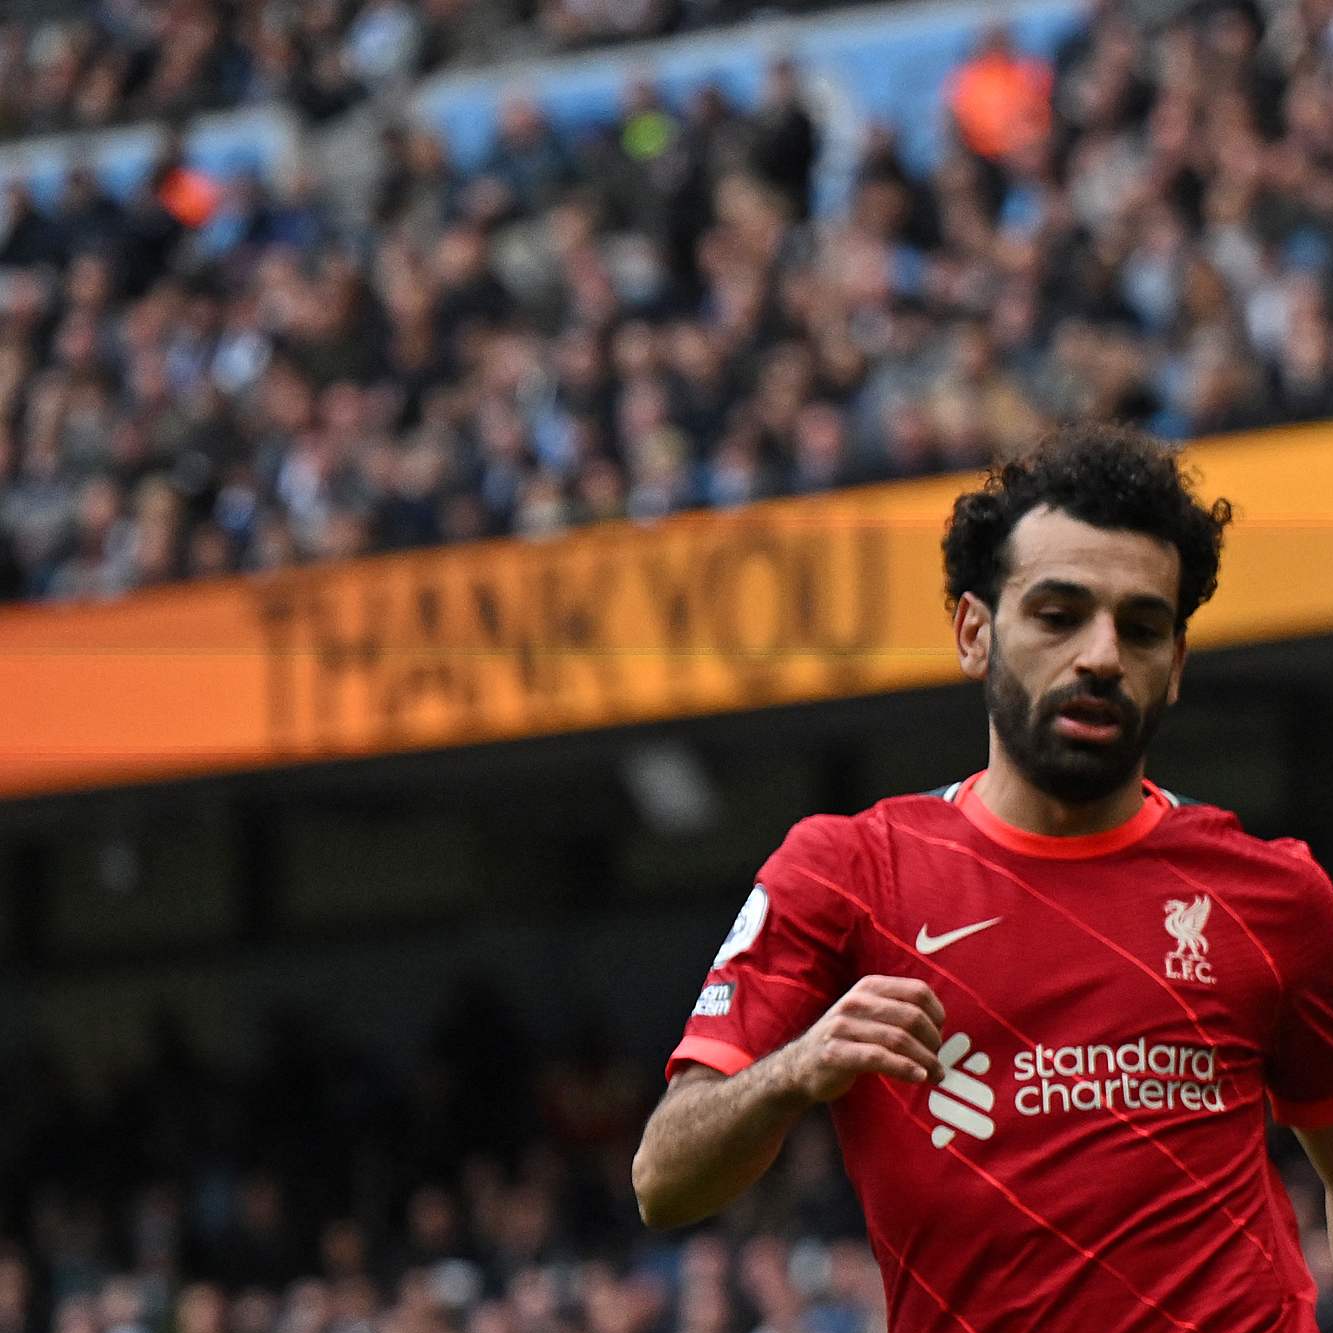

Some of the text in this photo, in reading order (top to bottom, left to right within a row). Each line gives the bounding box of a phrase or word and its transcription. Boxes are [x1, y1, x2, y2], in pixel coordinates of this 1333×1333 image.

[256, 516, 890, 752] THANK YOU
[1014, 1037, 1216, 1081] standard
[1014, 1073, 1227, 1116] chartered
